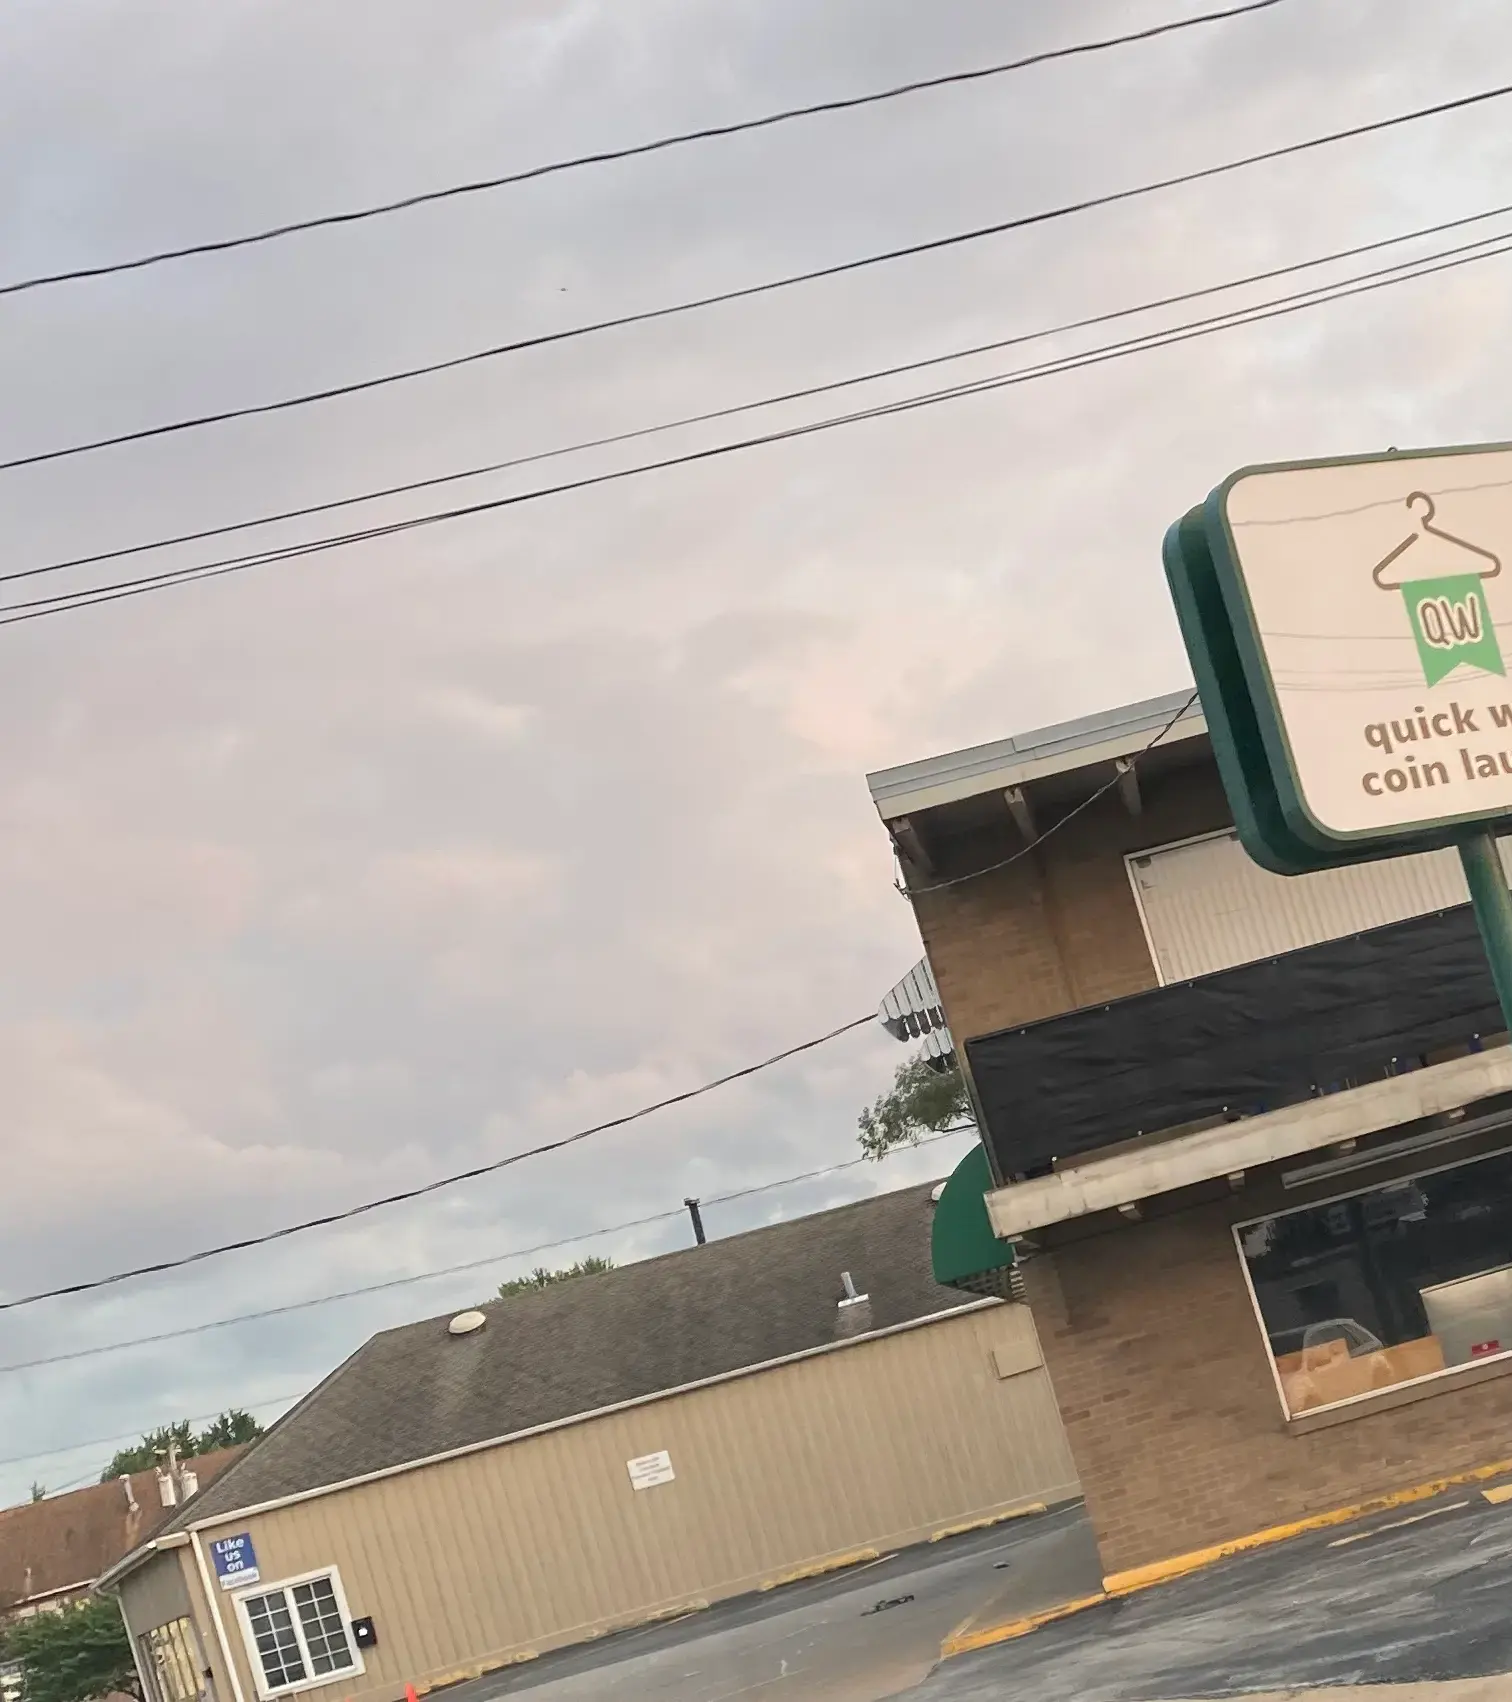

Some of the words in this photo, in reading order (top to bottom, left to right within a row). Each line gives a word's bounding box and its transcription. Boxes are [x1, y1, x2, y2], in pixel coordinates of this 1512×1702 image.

[1419, 596, 1481, 645] QW
[1364, 702, 1480, 754] quick
[1362, 755, 1450, 796] coin
[216, 1538, 244, 1554] Like
[225, 1550, 241, 1562] us
[227, 1560, 244, 1572] on
